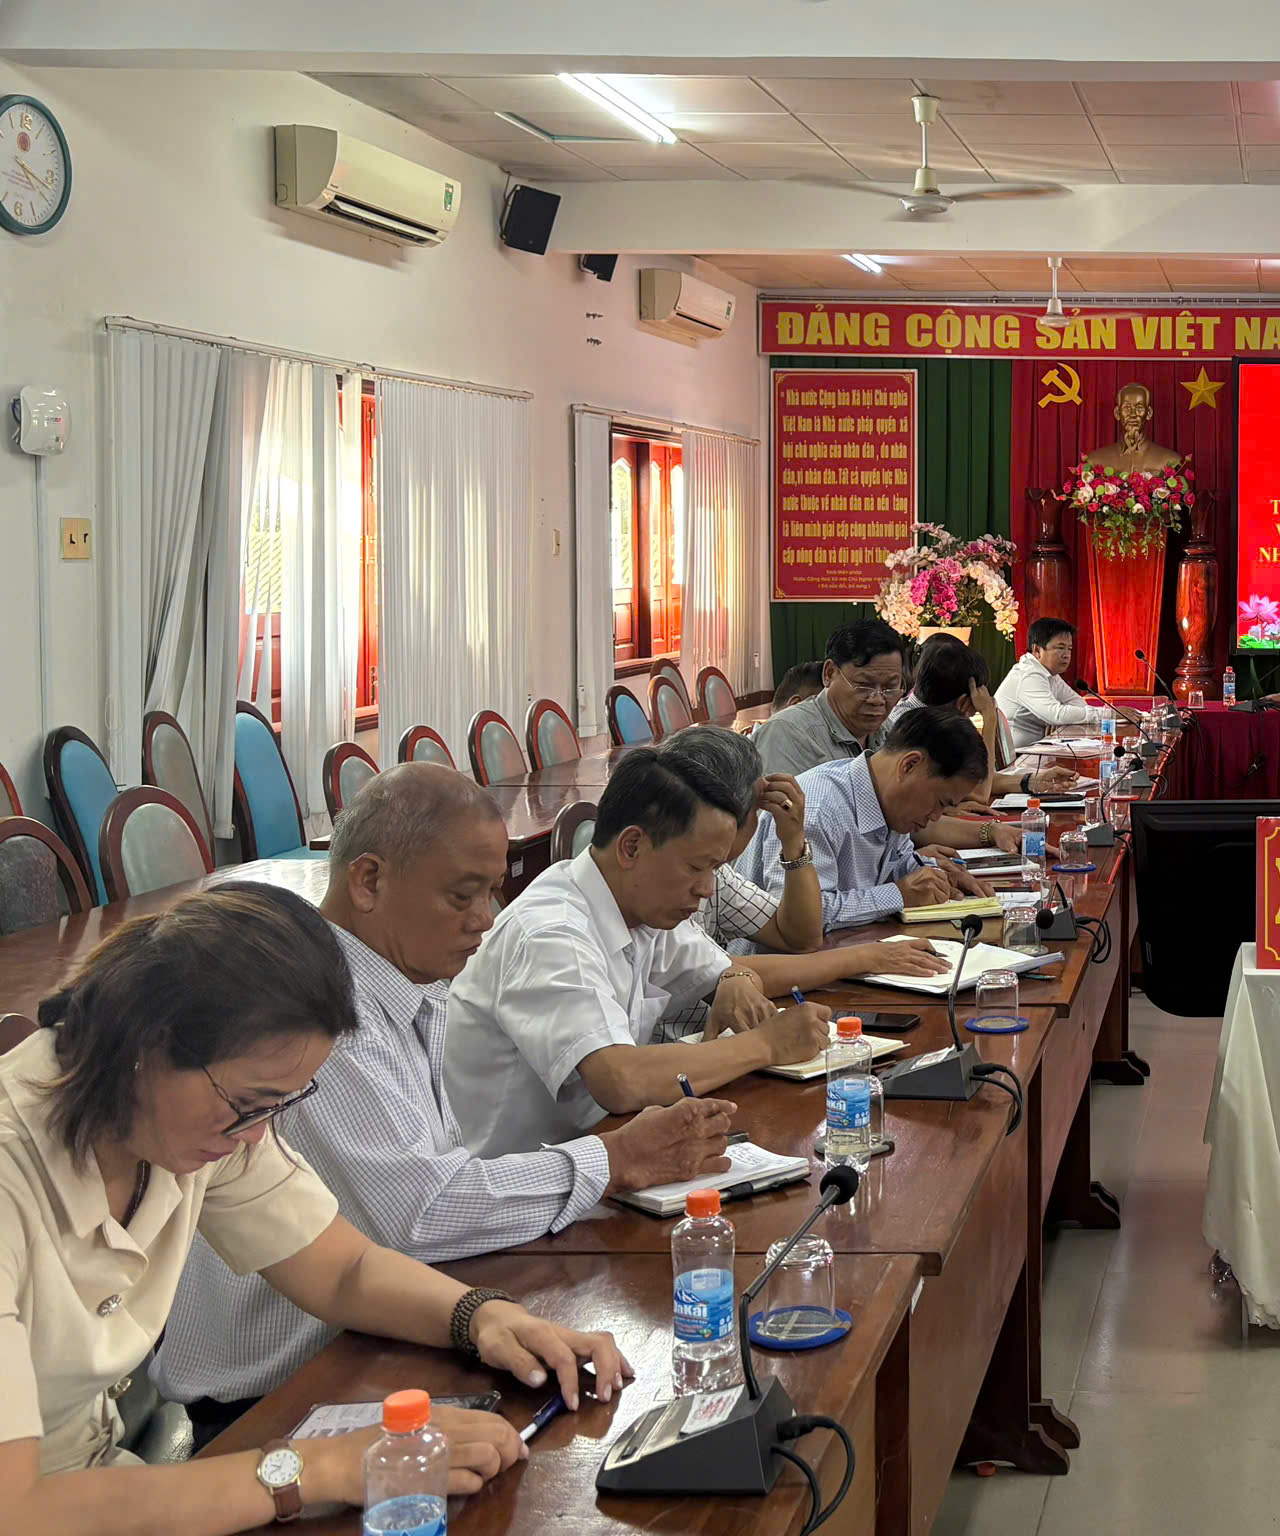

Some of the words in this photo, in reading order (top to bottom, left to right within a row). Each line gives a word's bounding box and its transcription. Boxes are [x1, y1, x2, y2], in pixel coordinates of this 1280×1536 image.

[20, 112, 32, 130] 12
[14, 201, 23, 217] 6
[776, 303, 890, 347] ĐẢNG
[905, 309, 1020, 354] CỘNG
[1035, 308, 1116, 350] SẢN
[1130, 310, 1221, 356] VIỆT
[801, 389, 817, 405] nước
[819, 389, 835, 408] Cộng
[852, 389, 860, 405] Xã
[863, 389, 872, 408] hội
[875, 388, 887, 405] Chủ
[889, 390, 908, 408] nghĩa
[783, 416, 796, 435] Việt
[798, 416, 812, 432] Nam
[815, 416, 820, 432] là
[823, 416, 835, 432] Nhà
[839, 416, 854, 432] nước
[857, 416, 873, 435] pháp
[900, 416, 908, 432] xã
[783, 442, 793, 461] hội
[795, 440, 807, 458] chủ
[809, 442, 827, 461] nghĩa
[830, 440, 841, 458] của
[844, 442, 859, 458] nhân
[881, 442, 888, 458] do
[891, 442, 907, 458] nhân
[805, 468, 821, 484] nhân
[851, 466, 858, 484] cả
[882, 468, 892, 488] lực
[895, 468, 908, 484] Nhà
[783, 495, 799, 511] nước
[801, 495, 819, 514] thuộc
[831, 495, 847, 511] nhân
[850, 495, 861, 511] dân
[864, 495, 874, 511] mà
[893, 494, 907, 513] tảng
[783, 520, 789, 536] là
[791, 520, 803, 536] liên
[805, 521, 821, 536] minh
[822, 521, 834, 539] giai
[837, 520, 848, 539] cấp
[851, 521, 866, 539] công
[867, 521, 883, 536] nhân
[895, 521, 907, 539] giai
[783, 547, 794, 566] cấp
[797, 547, 812, 566] nông
[815, 547, 826, 563] dân
[829, 547, 836, 563] và
[839, 547, 848, 566] đội
[851, 547, 862, 566] ngũ
